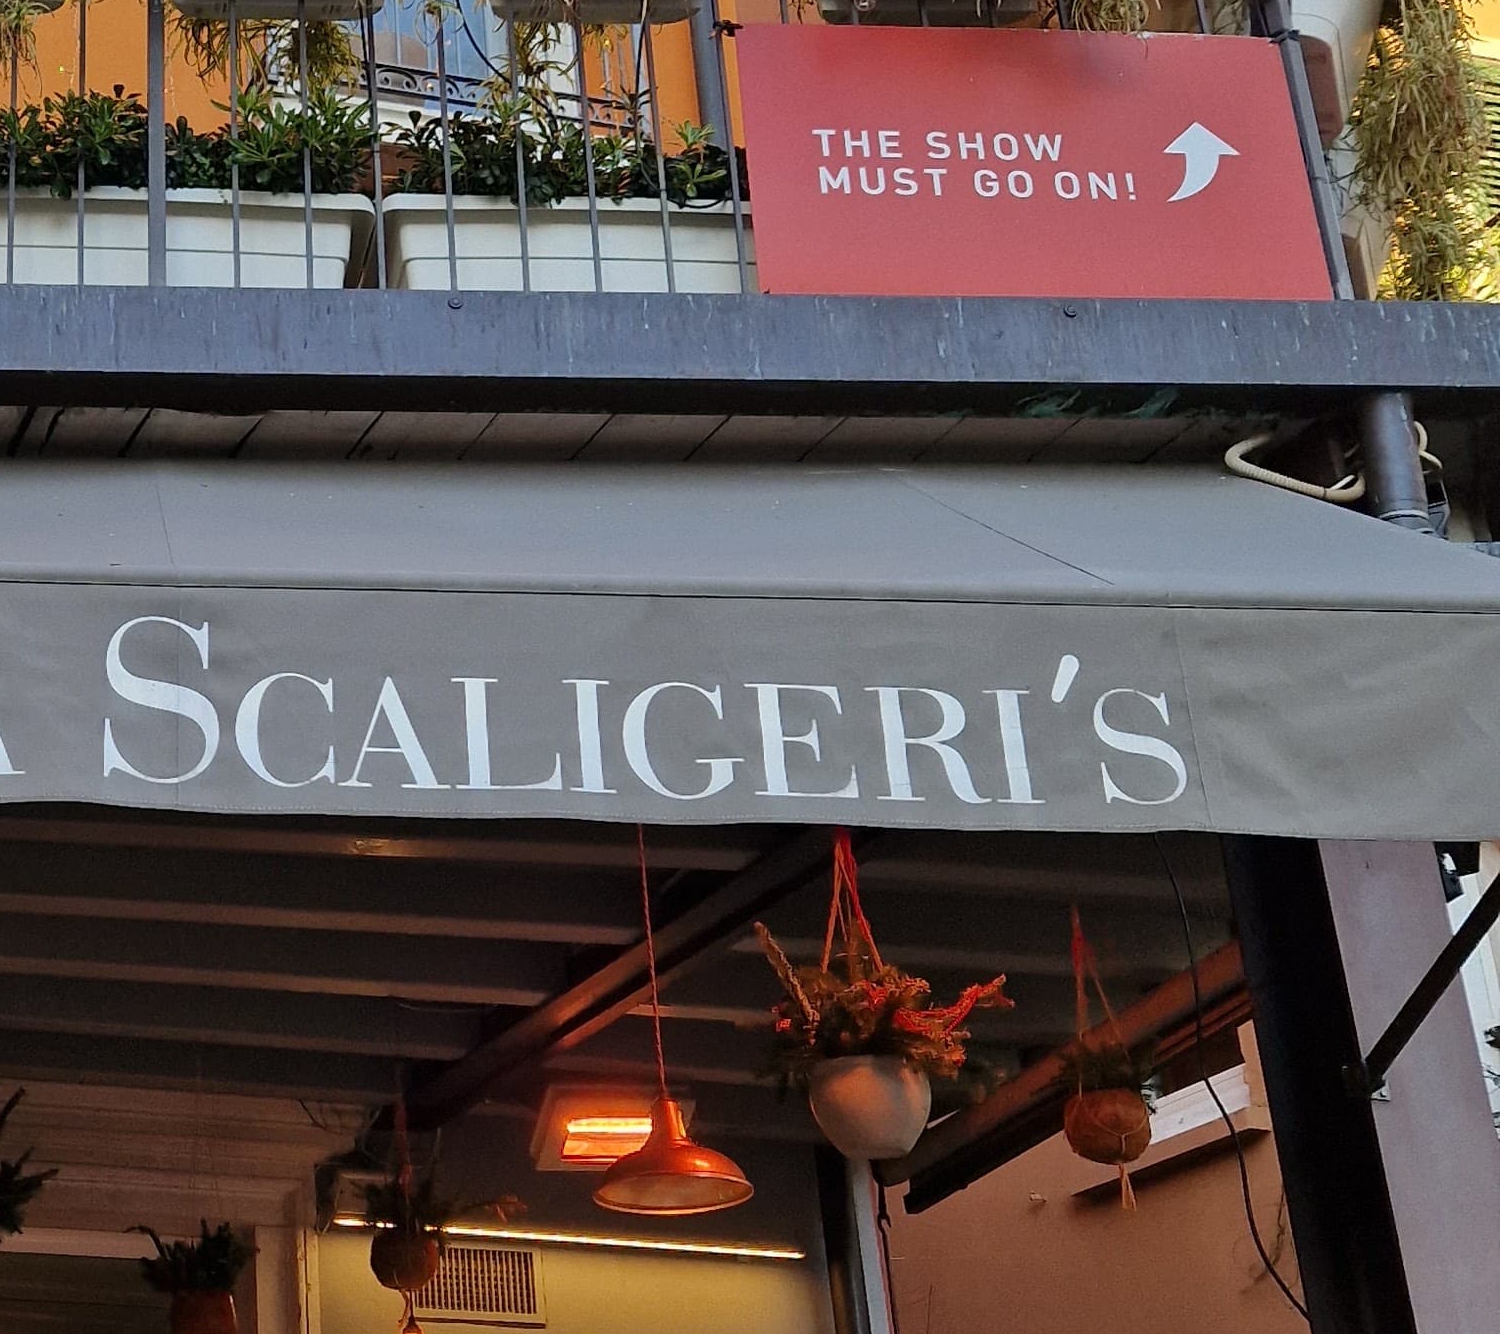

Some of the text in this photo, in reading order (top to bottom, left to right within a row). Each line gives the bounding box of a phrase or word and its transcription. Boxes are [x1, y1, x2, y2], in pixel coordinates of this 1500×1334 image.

[811, 128, 1063, 162] THE SHOW
[818, 166, 1138, 201] MUST GO ON!
